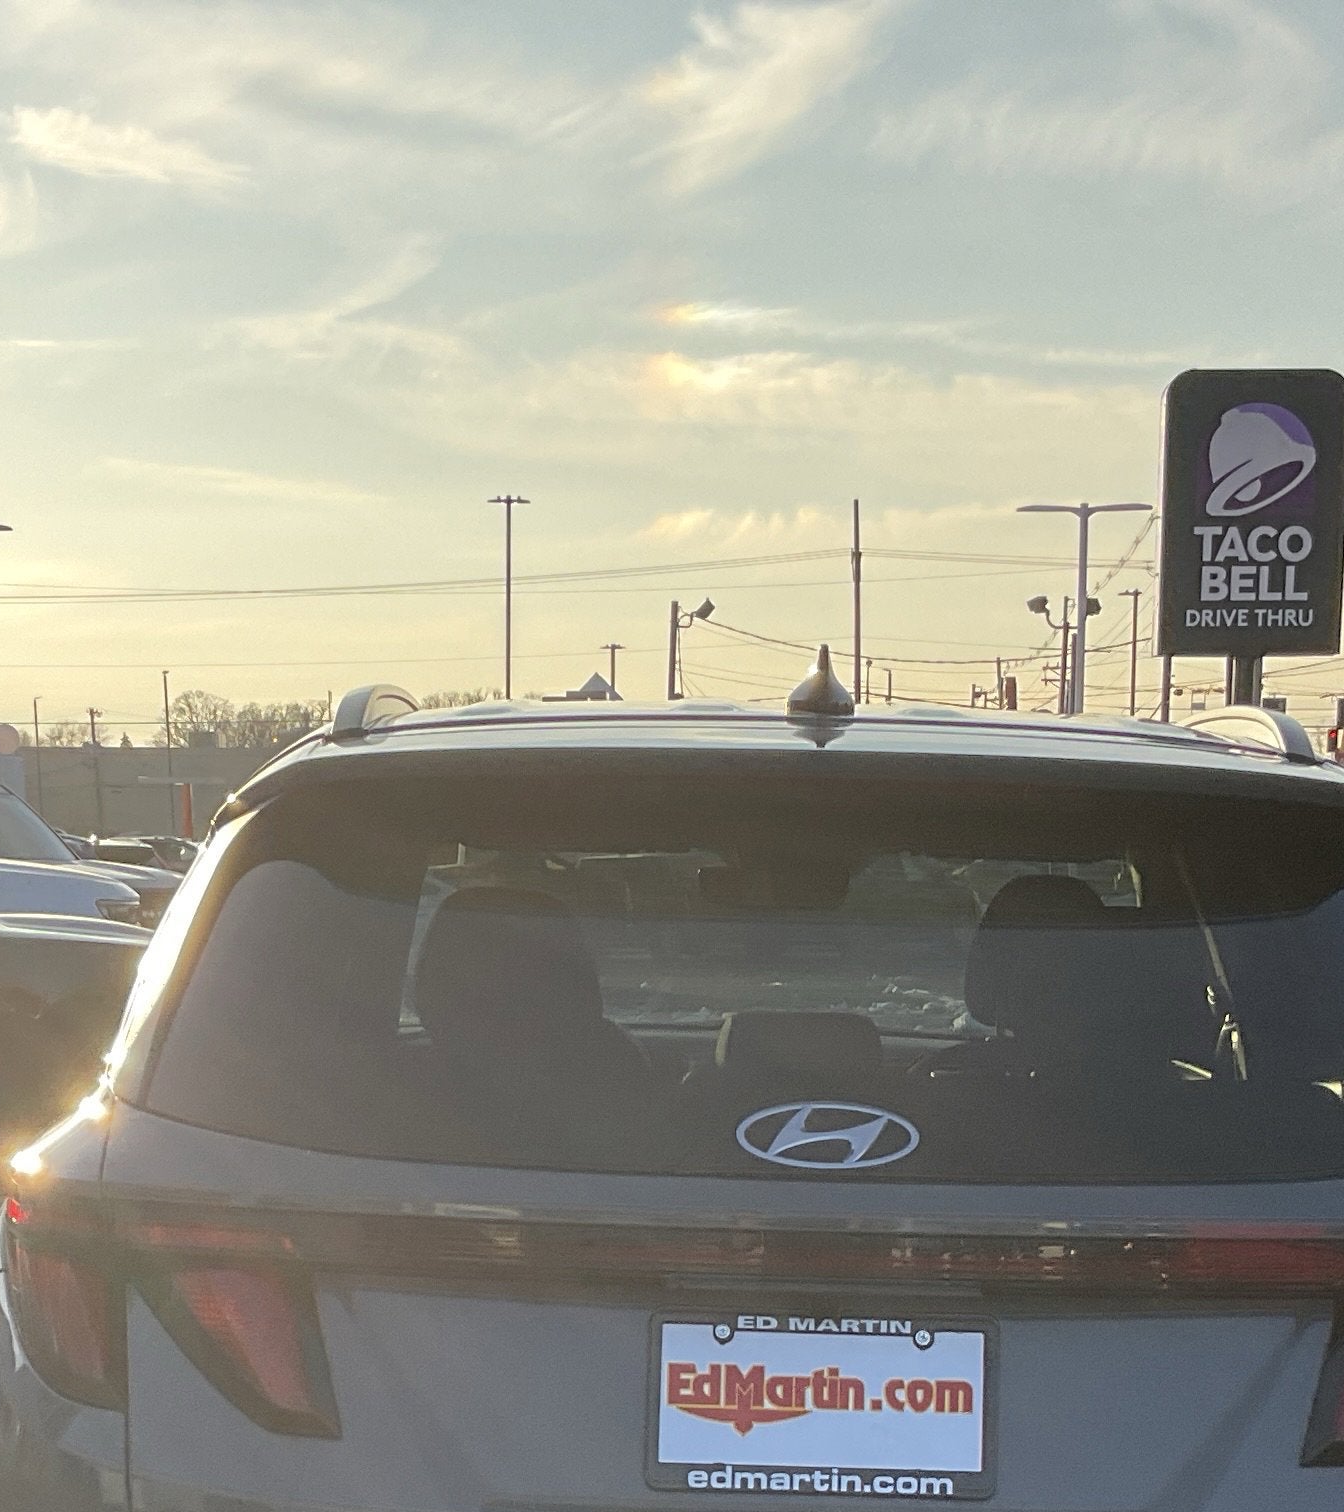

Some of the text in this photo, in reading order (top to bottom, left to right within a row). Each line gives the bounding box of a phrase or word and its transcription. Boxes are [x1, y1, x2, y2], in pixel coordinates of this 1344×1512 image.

[1193, 525, 1312, 562] TACO
[1200, 565, 1308, 602] BELL
[1185, 608, 1313, 627] DRIVE THRU
[737, 1315, 912, 1335] ED MARTIN
[666, 1362, 974, 1420] EdMartin.com
[687, 1466, 954, 1496] edmartin.com
